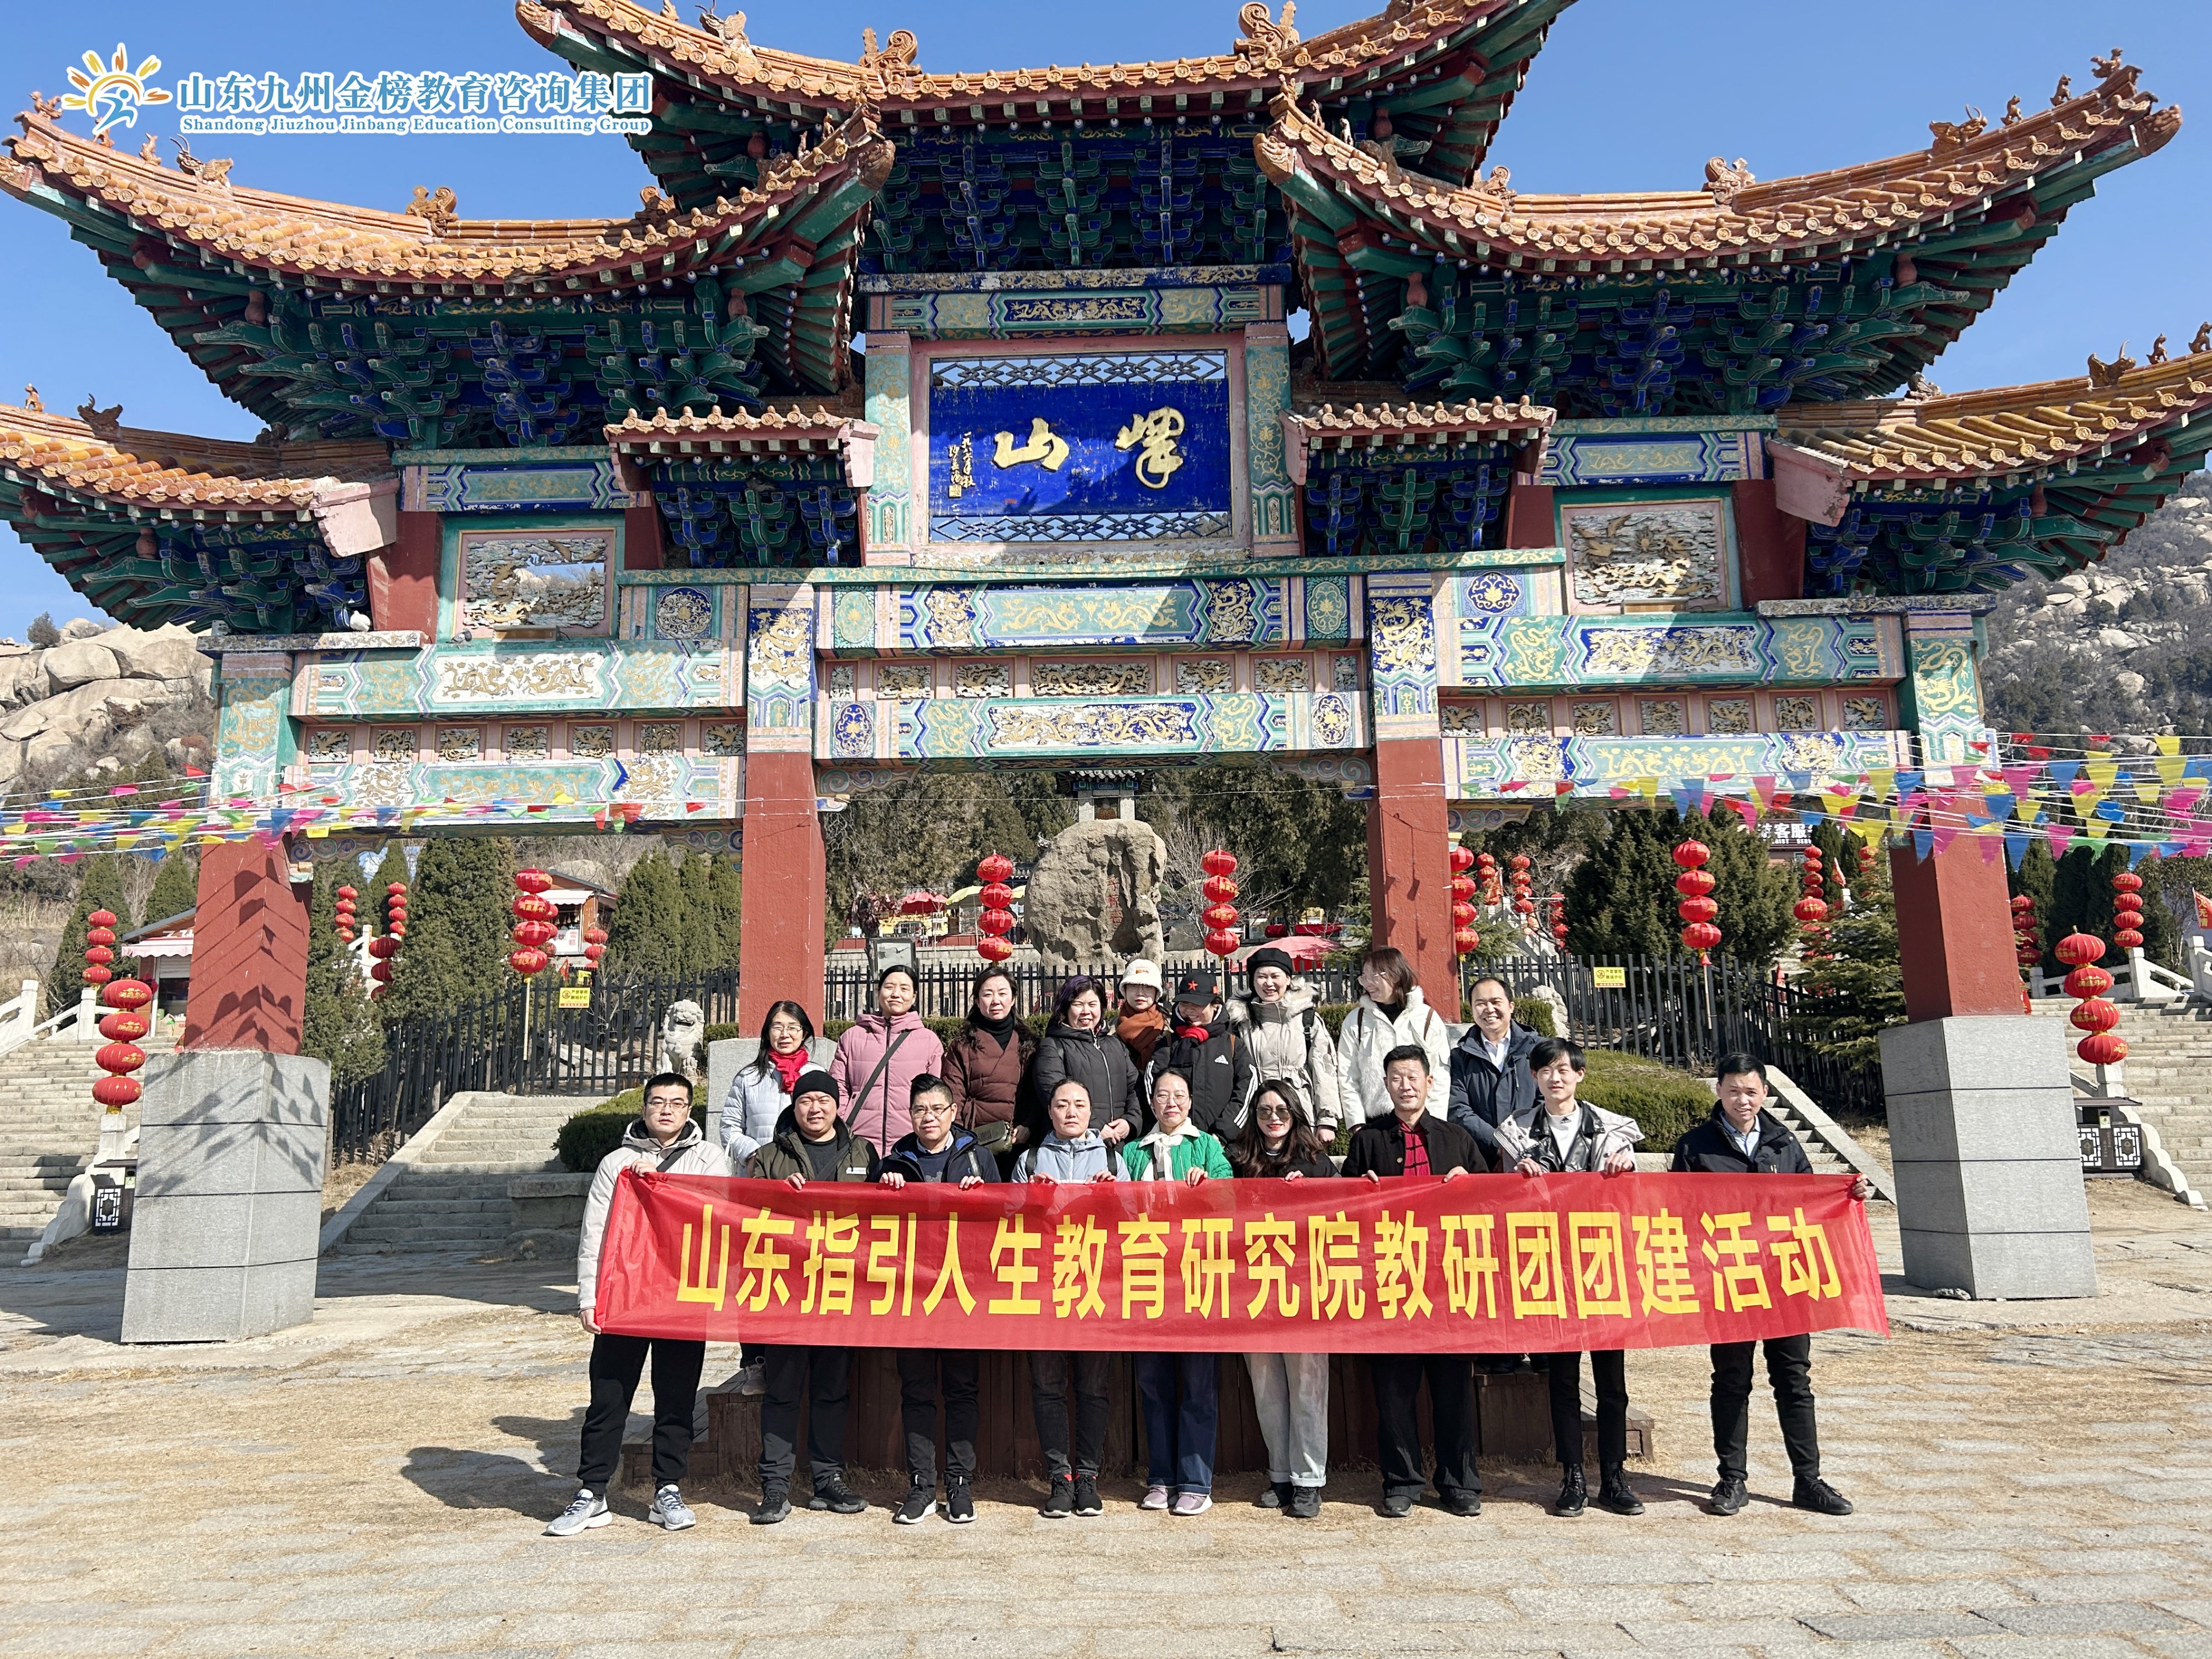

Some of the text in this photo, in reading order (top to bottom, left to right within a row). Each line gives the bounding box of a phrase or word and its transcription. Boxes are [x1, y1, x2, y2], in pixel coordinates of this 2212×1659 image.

[676, 1204, 1842, 1320] 山东指引人生教育研究院教研团团建活动
